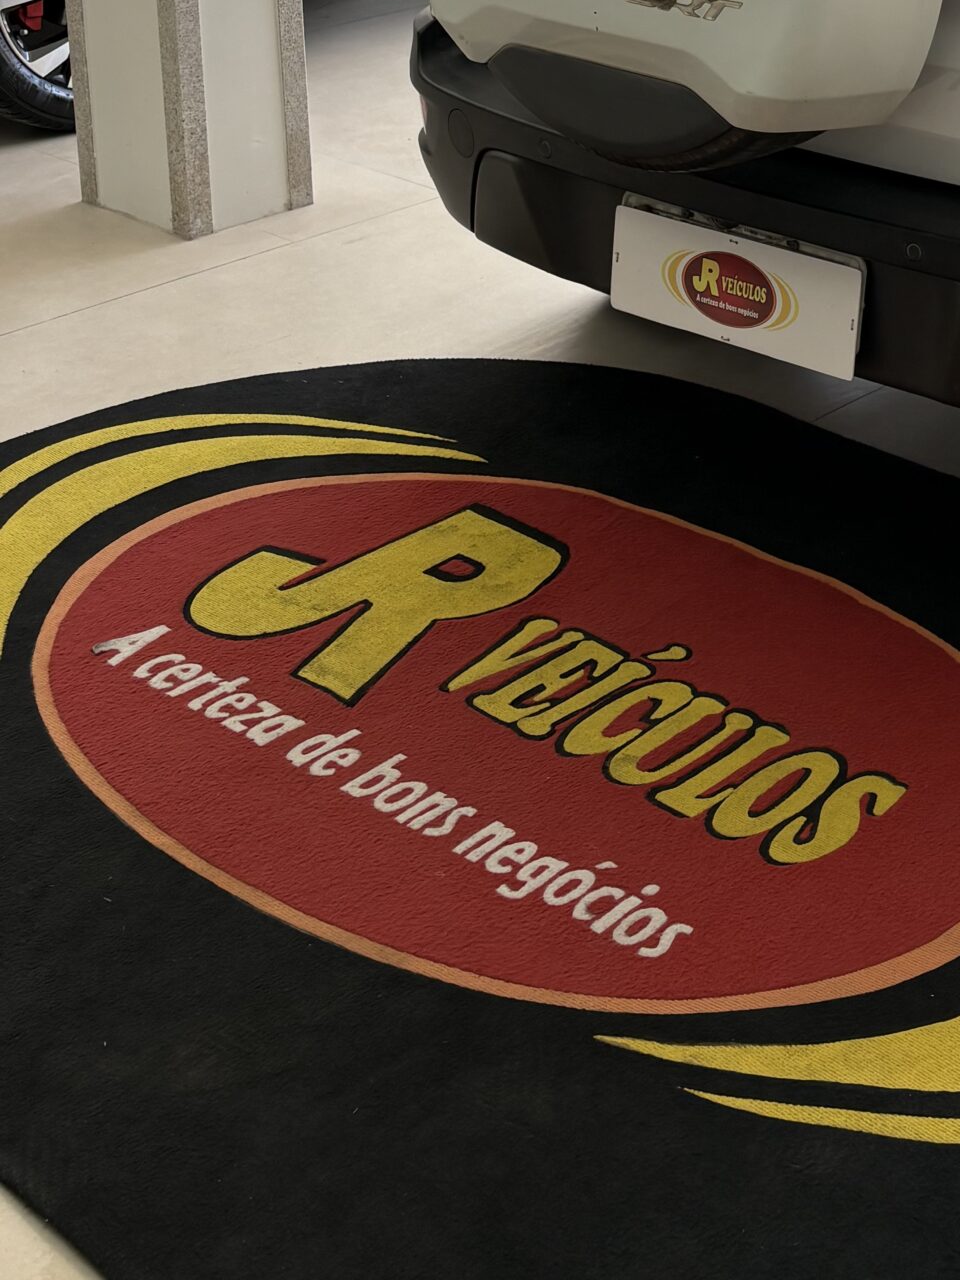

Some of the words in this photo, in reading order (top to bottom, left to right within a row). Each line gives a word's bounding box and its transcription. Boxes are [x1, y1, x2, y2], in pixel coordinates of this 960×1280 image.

[693, 258, 719, 296] JR
[722, 275, 767, 303] VEÍCULOS
[92, 624, 173, 668] A
[183, 504, 569, 707] JR
[439, 615, 909, 868] VEÍCULOS
[130, 649, 294, 748] certeza
[285, 725, 364, 780] de
[340, 755, 480, 838] bons
[452, 820, 696, 960] negócios
